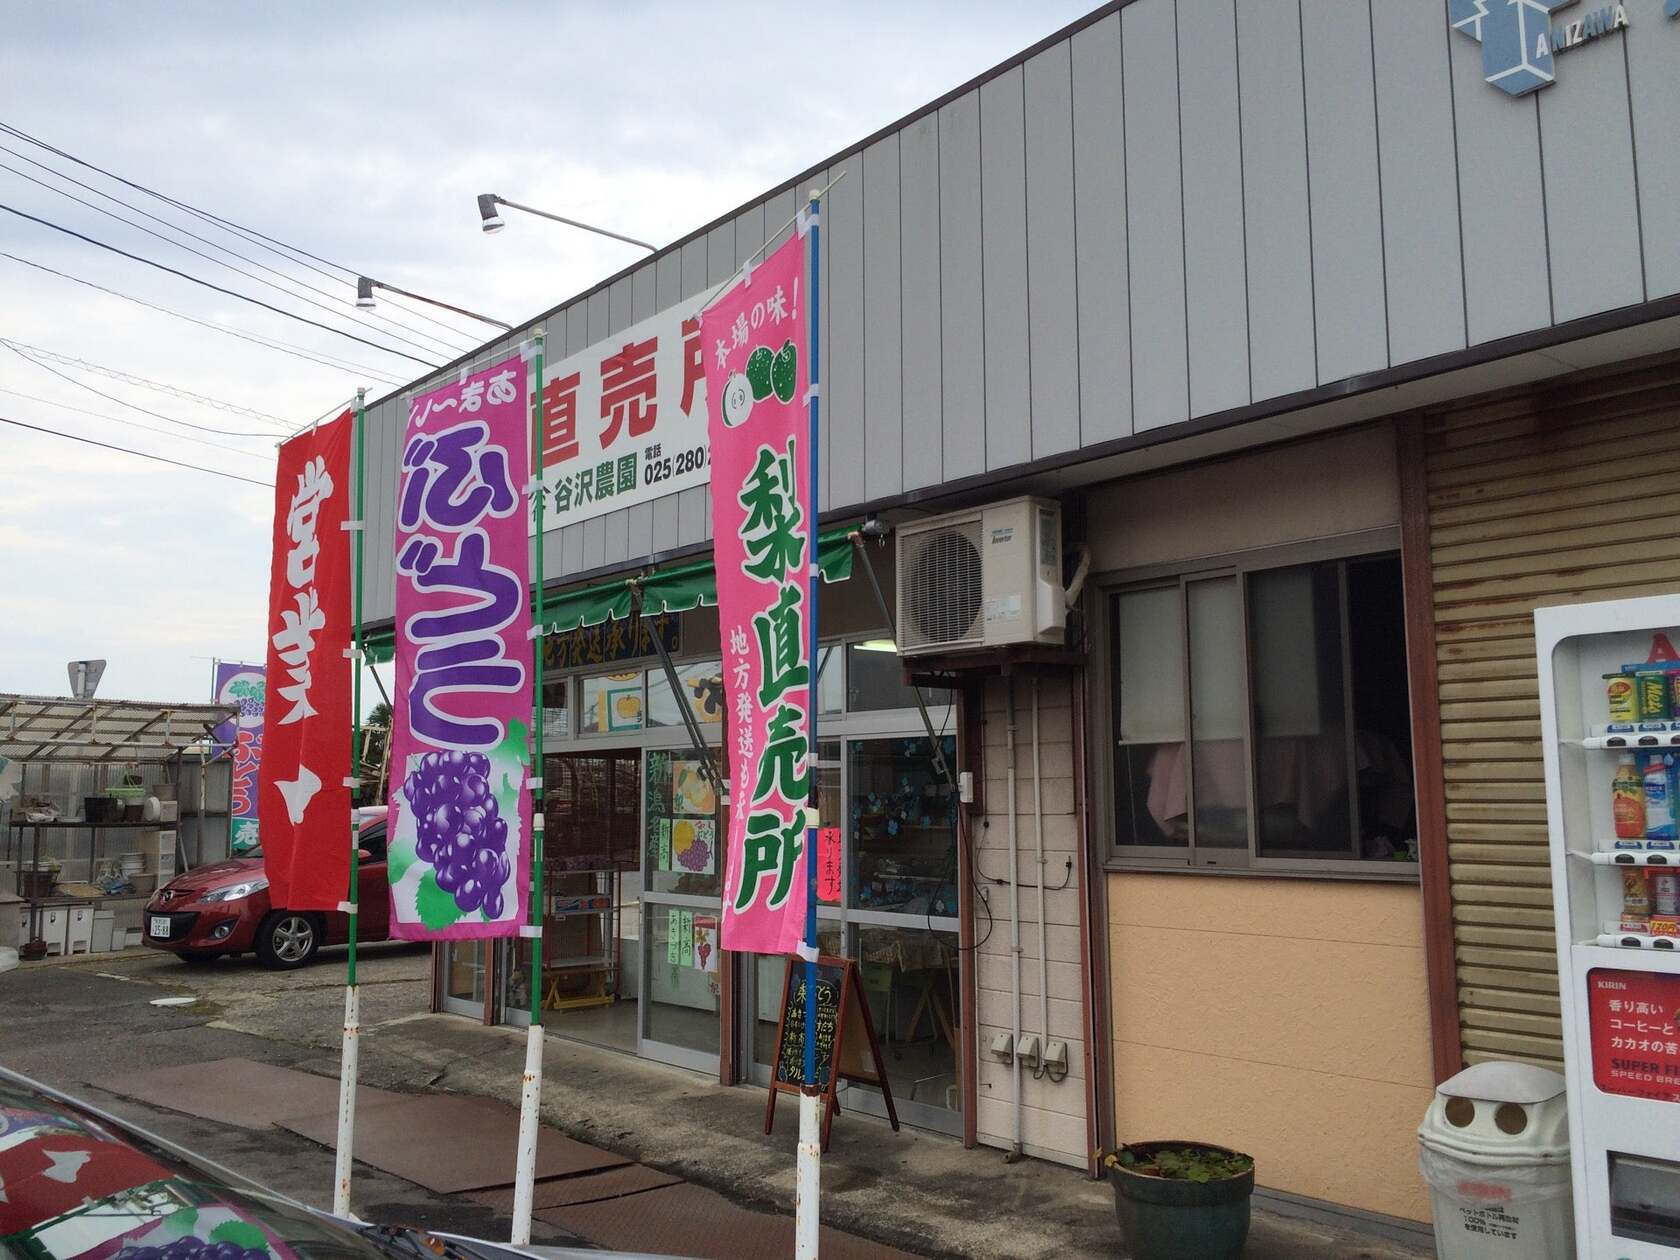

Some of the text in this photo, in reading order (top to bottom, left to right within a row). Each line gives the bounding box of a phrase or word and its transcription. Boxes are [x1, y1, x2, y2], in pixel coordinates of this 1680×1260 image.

[715, 276, 799, 369] 本場の味!
[644, 442, 662, 461] 電話
[644, 445, 711, 486] 025(280)
[735, 435, 809, 912] 梨直売所
[1597, 980, 1627, 991] KIRIN
[1608, 999, 1664, 1015] 香り高い
[1610, 1018, 1675, 1036] コーヒーと
[1611, 1058, 1660, 1073] SUPER
[1611, 1070, 1653, 1081] SPEED
